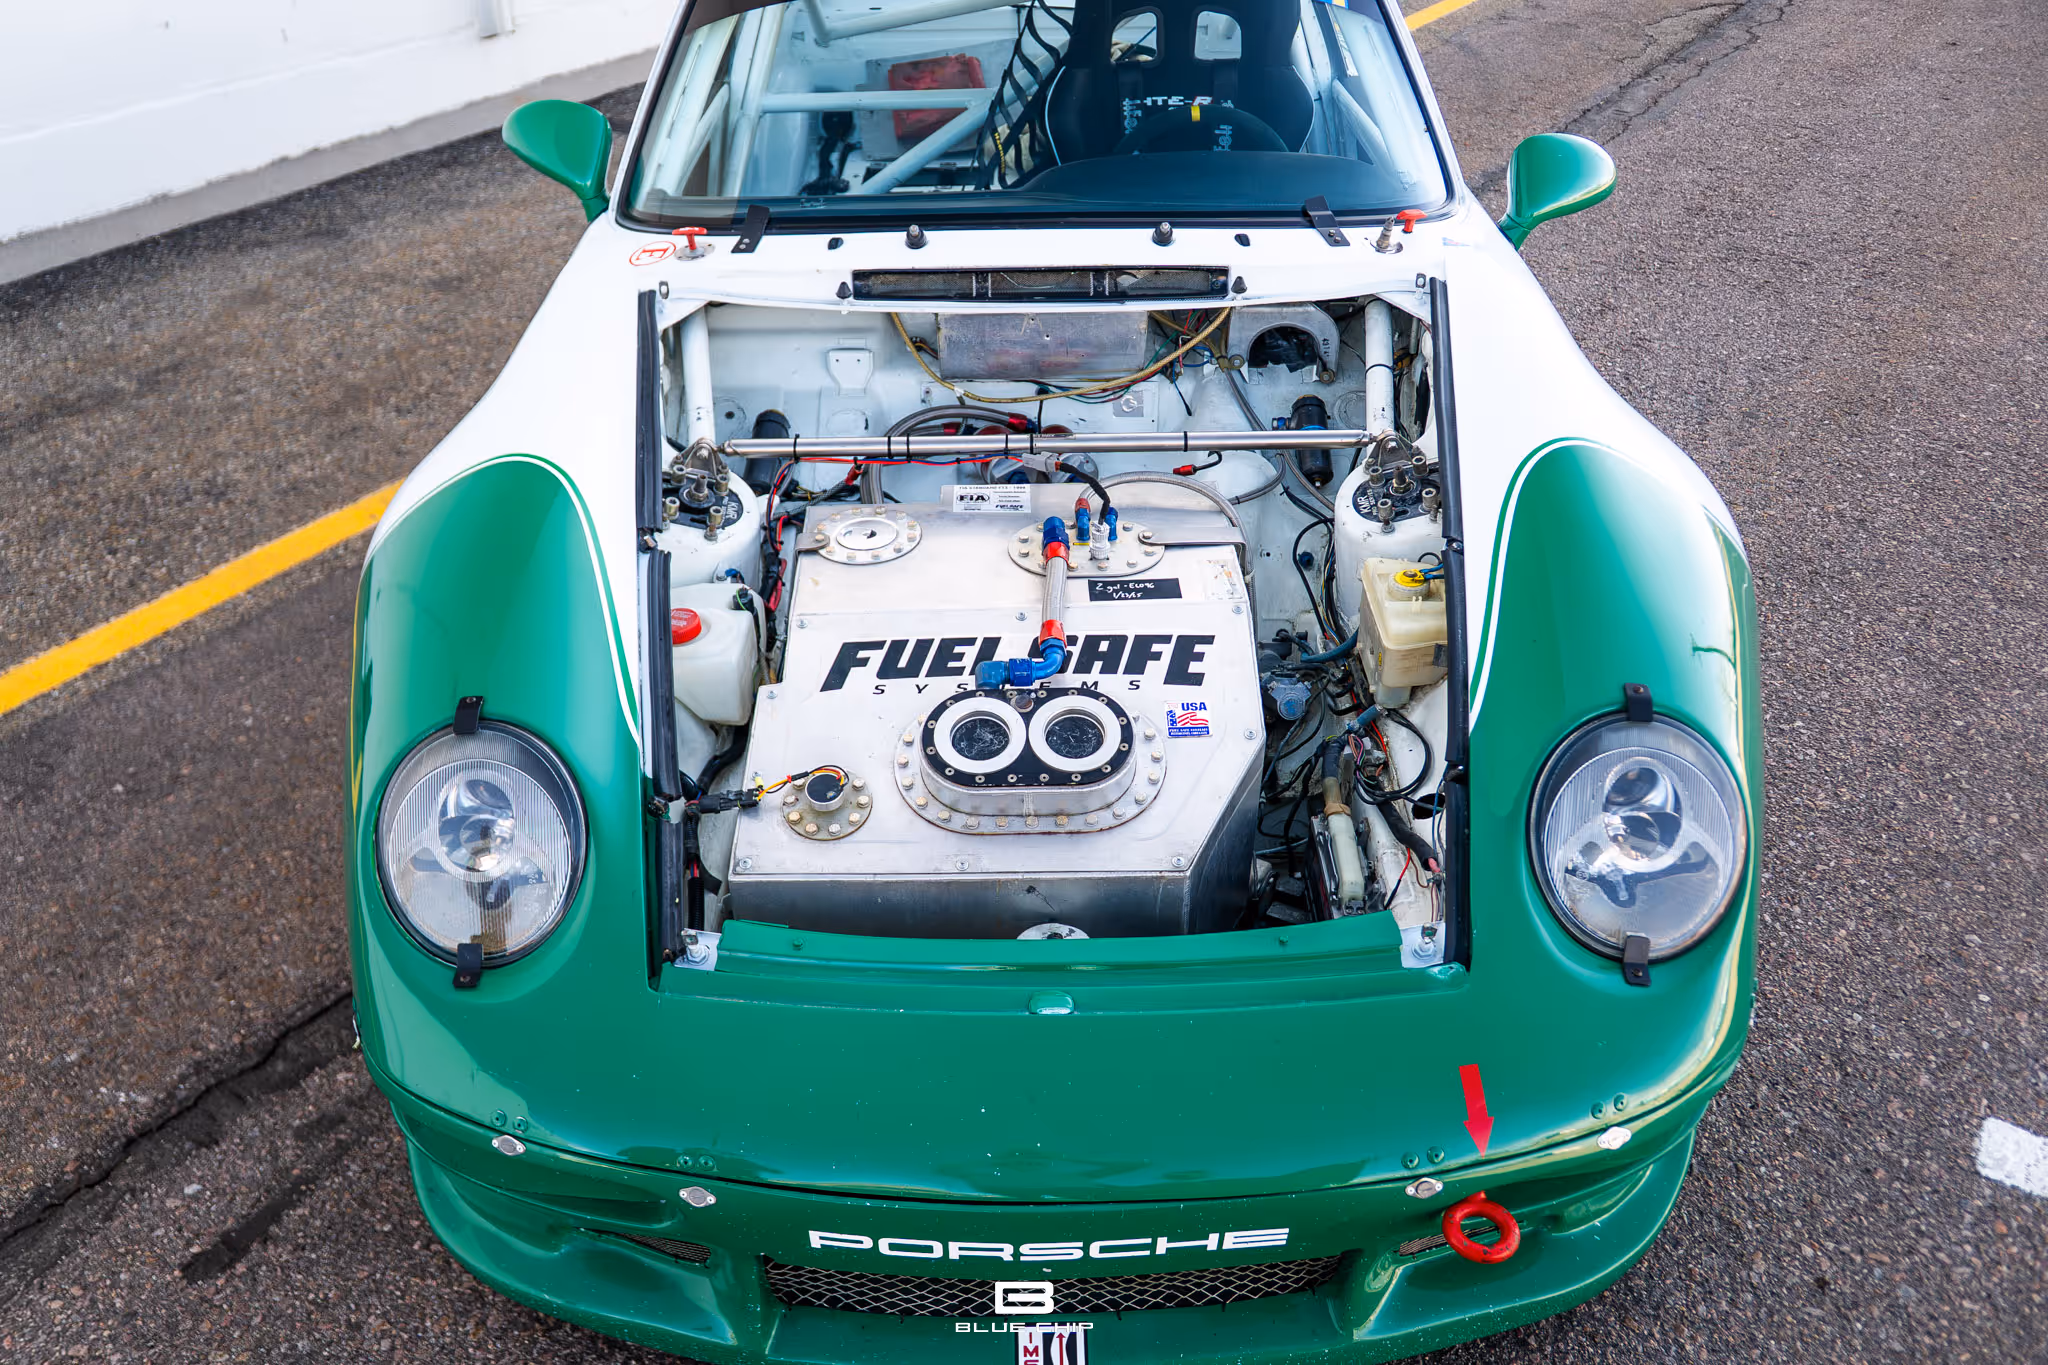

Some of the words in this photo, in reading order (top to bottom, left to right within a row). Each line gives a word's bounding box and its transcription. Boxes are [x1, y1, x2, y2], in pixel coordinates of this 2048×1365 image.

[1357, 495, 1372, 514] KMR
[1181, 701, 1207, 712] USA
[808, 1227, 1290, 1261] PORSCHE
